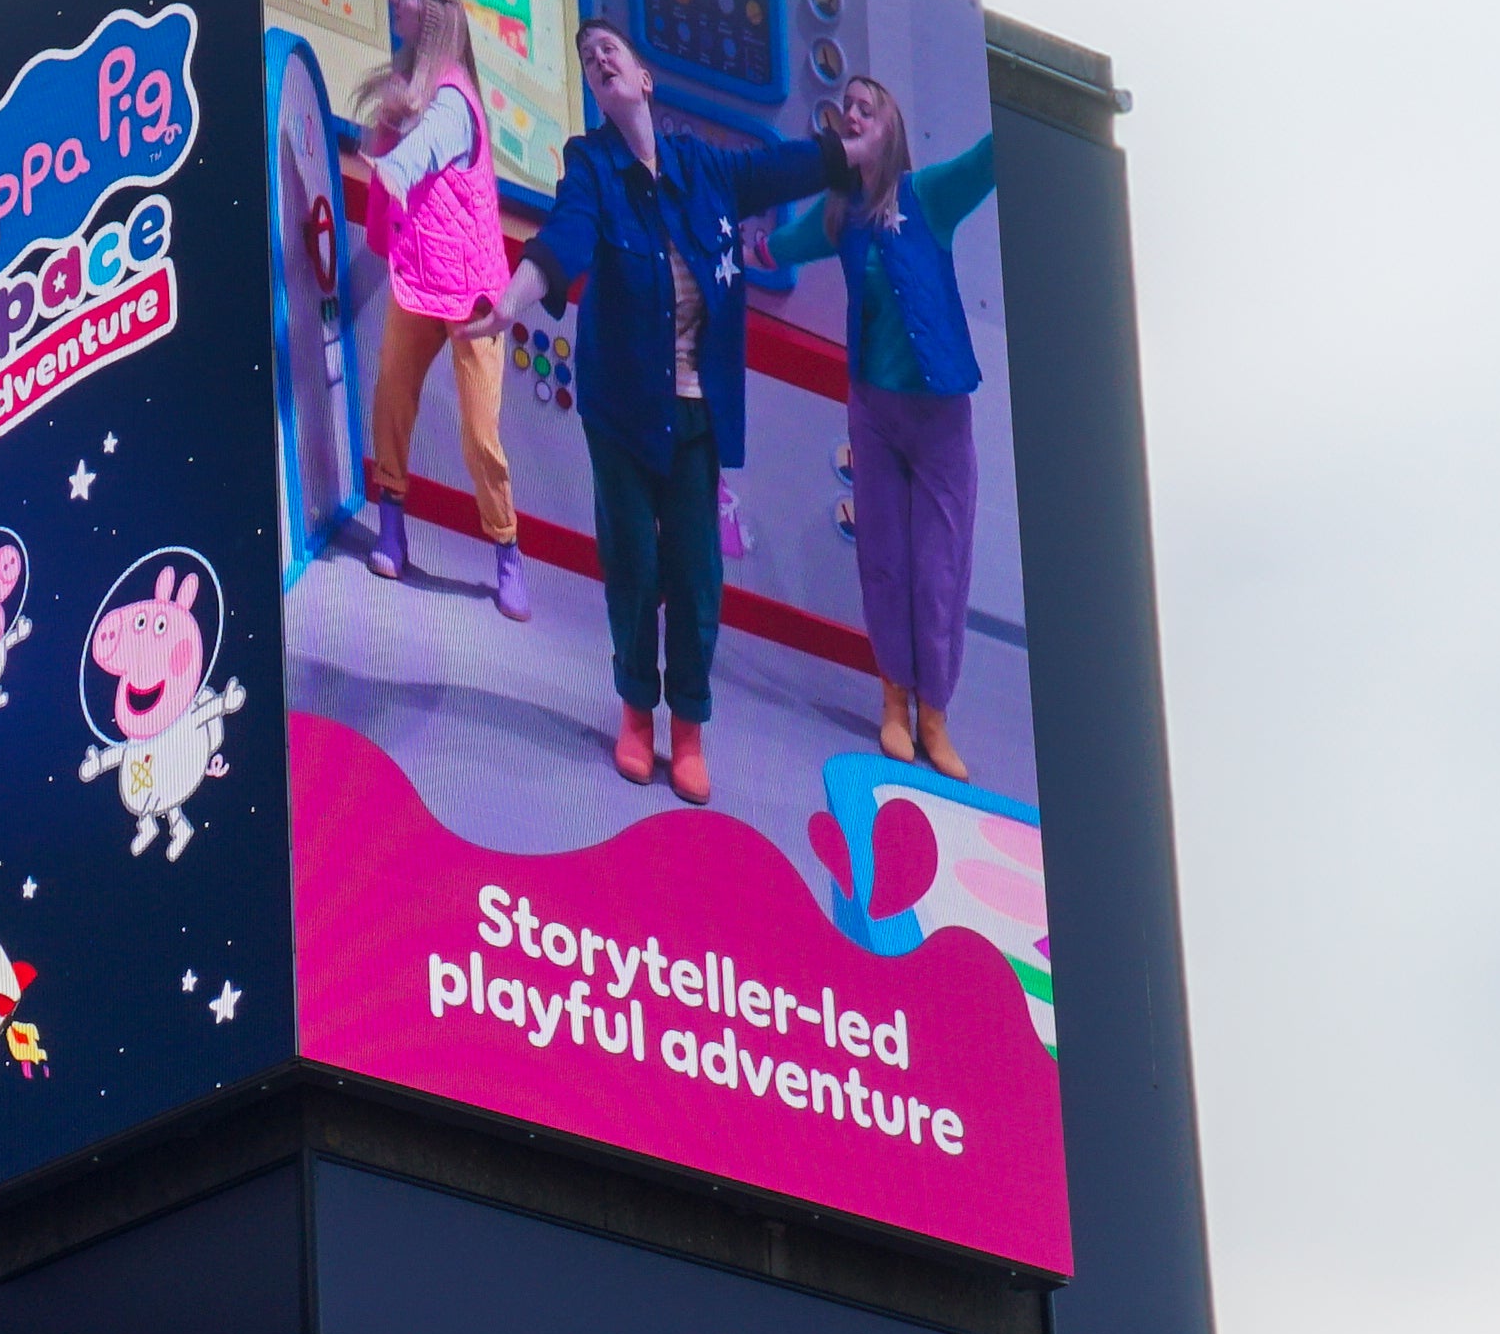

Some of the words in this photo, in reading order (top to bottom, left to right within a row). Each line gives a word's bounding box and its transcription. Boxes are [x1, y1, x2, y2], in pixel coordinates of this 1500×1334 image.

[98, 46, 182, 158] Pig
[428, 953, 645, 1062] playful
[660, 1027, 965, 1156] adventure
[478, 884, 910, 1071] Storyteller-led
